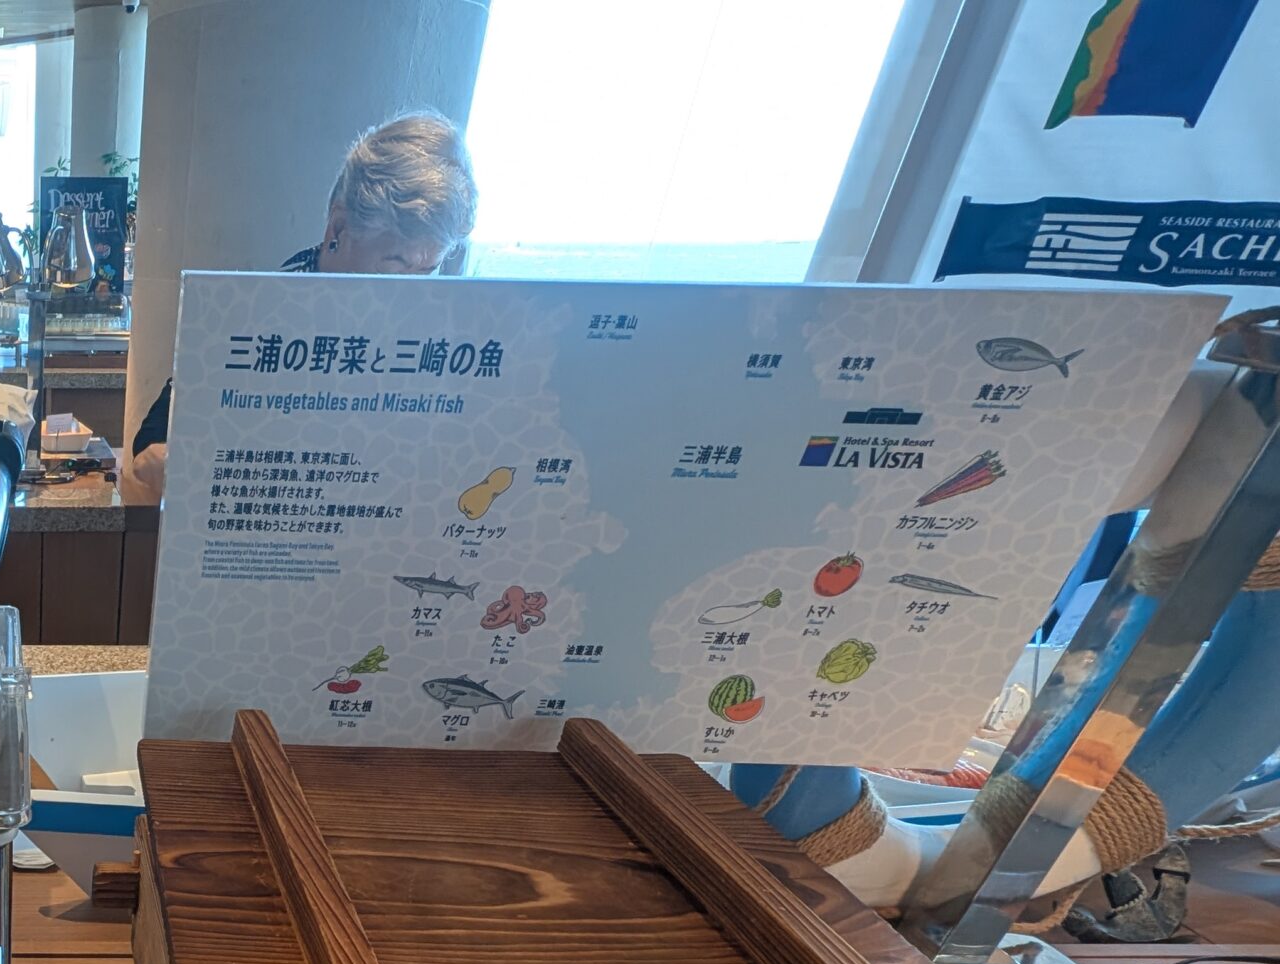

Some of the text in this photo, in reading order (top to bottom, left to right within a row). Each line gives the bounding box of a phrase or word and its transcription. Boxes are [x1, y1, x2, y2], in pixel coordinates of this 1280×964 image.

[1159, 215, 1213, 227] SEASIDE
[1170, 266, 1277, 278] Kannonzaki Terrace
[225, 334, 504, 377] 三浦の野菜と三崎の魚
[975, 384, 1032, 401] 黄金アジ
[221, 389, 464, 414] Miura vegetables and Misaki fish
[843, 436, 934, 449] Hotel & Spa Resort
[679, 445, 742, 465] 三浦半島
[833, 447, 924, 469] LA VISTA
[536, 458, 573, 473] 相模湾
[896, 515, 978, 530] カラフルニンジン
[442, 523, 507, 539] バターナッツ
[411, 606, 442, 619] カマス
[806, 605, 835, 618] トマト
[905, 601, 950, 615] タチウオ
[701, 632, 750, 645] 三浦大根
[808, 689, 850, 702] キャベツ
[442, 715, 469, 727] マグロ
[705, 726, 735, 738] すいか
